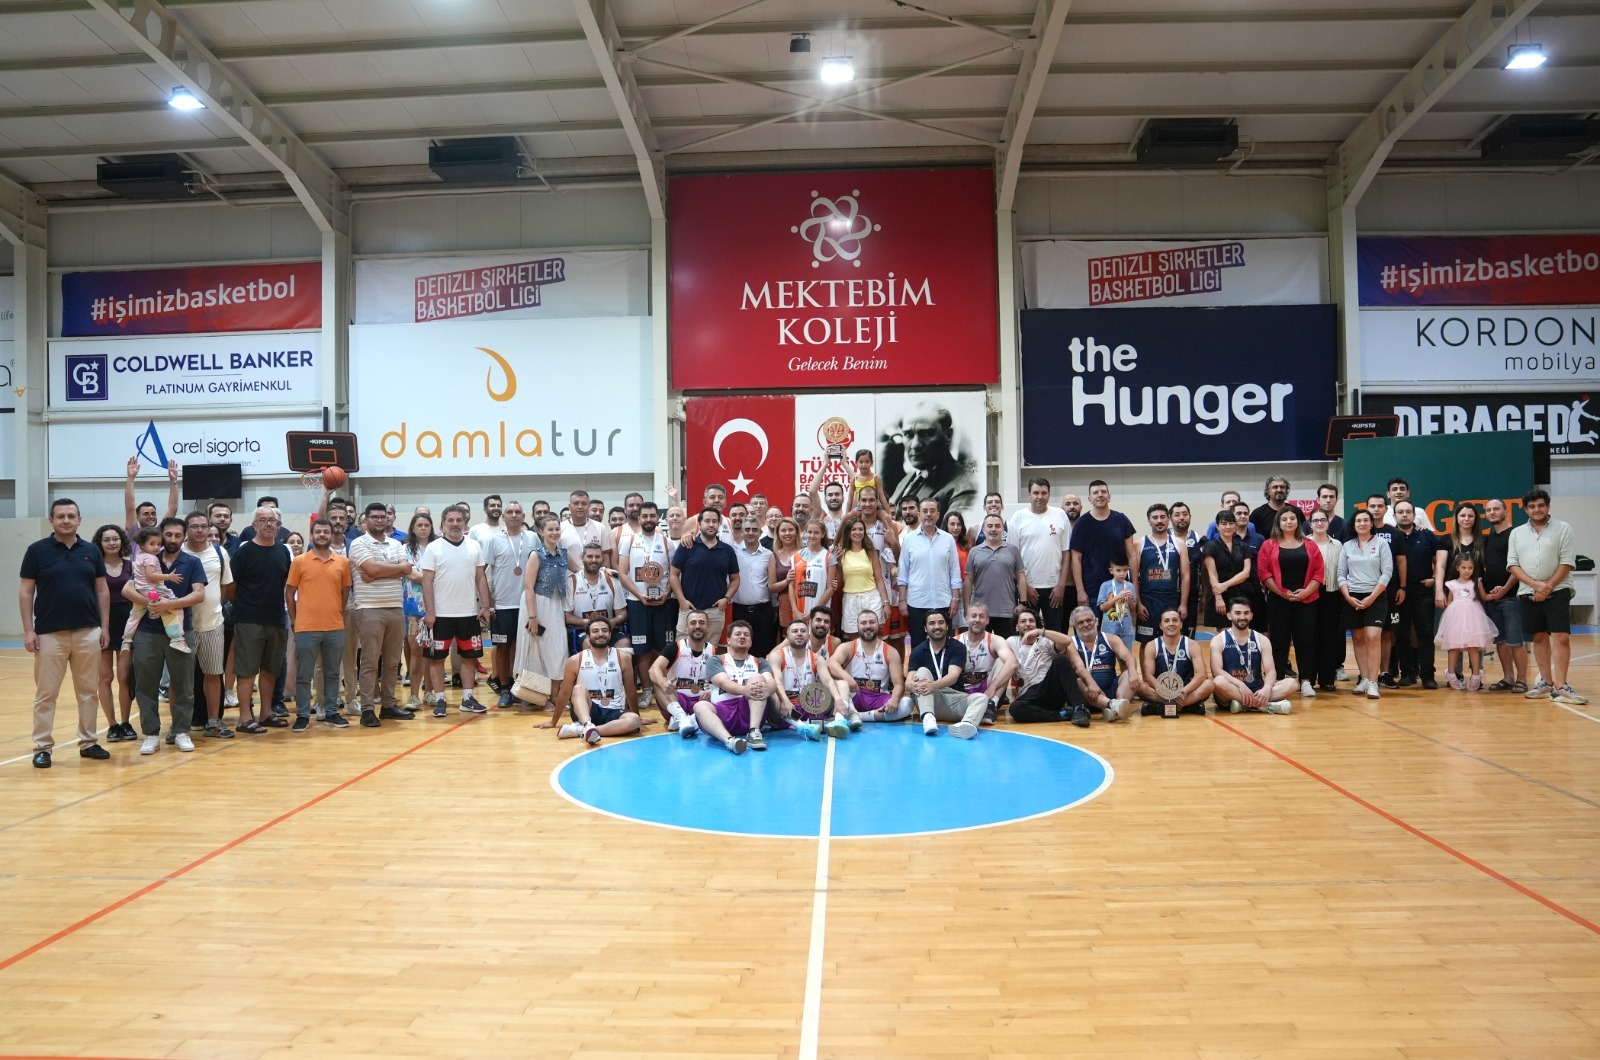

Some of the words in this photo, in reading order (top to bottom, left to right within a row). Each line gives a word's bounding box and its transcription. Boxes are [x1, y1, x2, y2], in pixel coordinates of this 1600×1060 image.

[417, 274, 475, 298] DENİZLİ
[481, 259, 564, 291] ŞİRKETLER
[1090, 254, 1153, 280] DENİZLİ
[1159, 244, 1243, 275] ŞİRKETLER
[1380, 249, 1600, 293] #işimizbasketbo
[91, 274, 295, 324] #işimizbasketbol
[417, 291, 505, 320] BASKETBOL
[510, 284, 540, 308] LİGİ
[740, 271, 935, 310] MEKTEBİM
[1091, 274, 1185, 303] BASKETBOL
[1190, 269, 1220, 291] LİGİ
[777, 310, 898, 351] KOLEJİ
[1416, 316, 1595, 347] KORDON
[113, 353, 223, 373] COLDWELL
[230, 350, 313, 370] BANKER
[788, 357, 839, 371] Gelecek
[842, 356, 888, 371] Benim
[1068, 336, 1138, 373] the
[1505, 352, 1595, 374] mobilya
[146, 383, 205, 395] PLATINUM
[208, 379, 292, 393] GAYRİMENKUL
[1072, 375, 1293, 435] Hunger
[172, 438, 203, 454] arel
[206, 437, 261, 457] sigorta
[665, 631, 674, 642] 18
